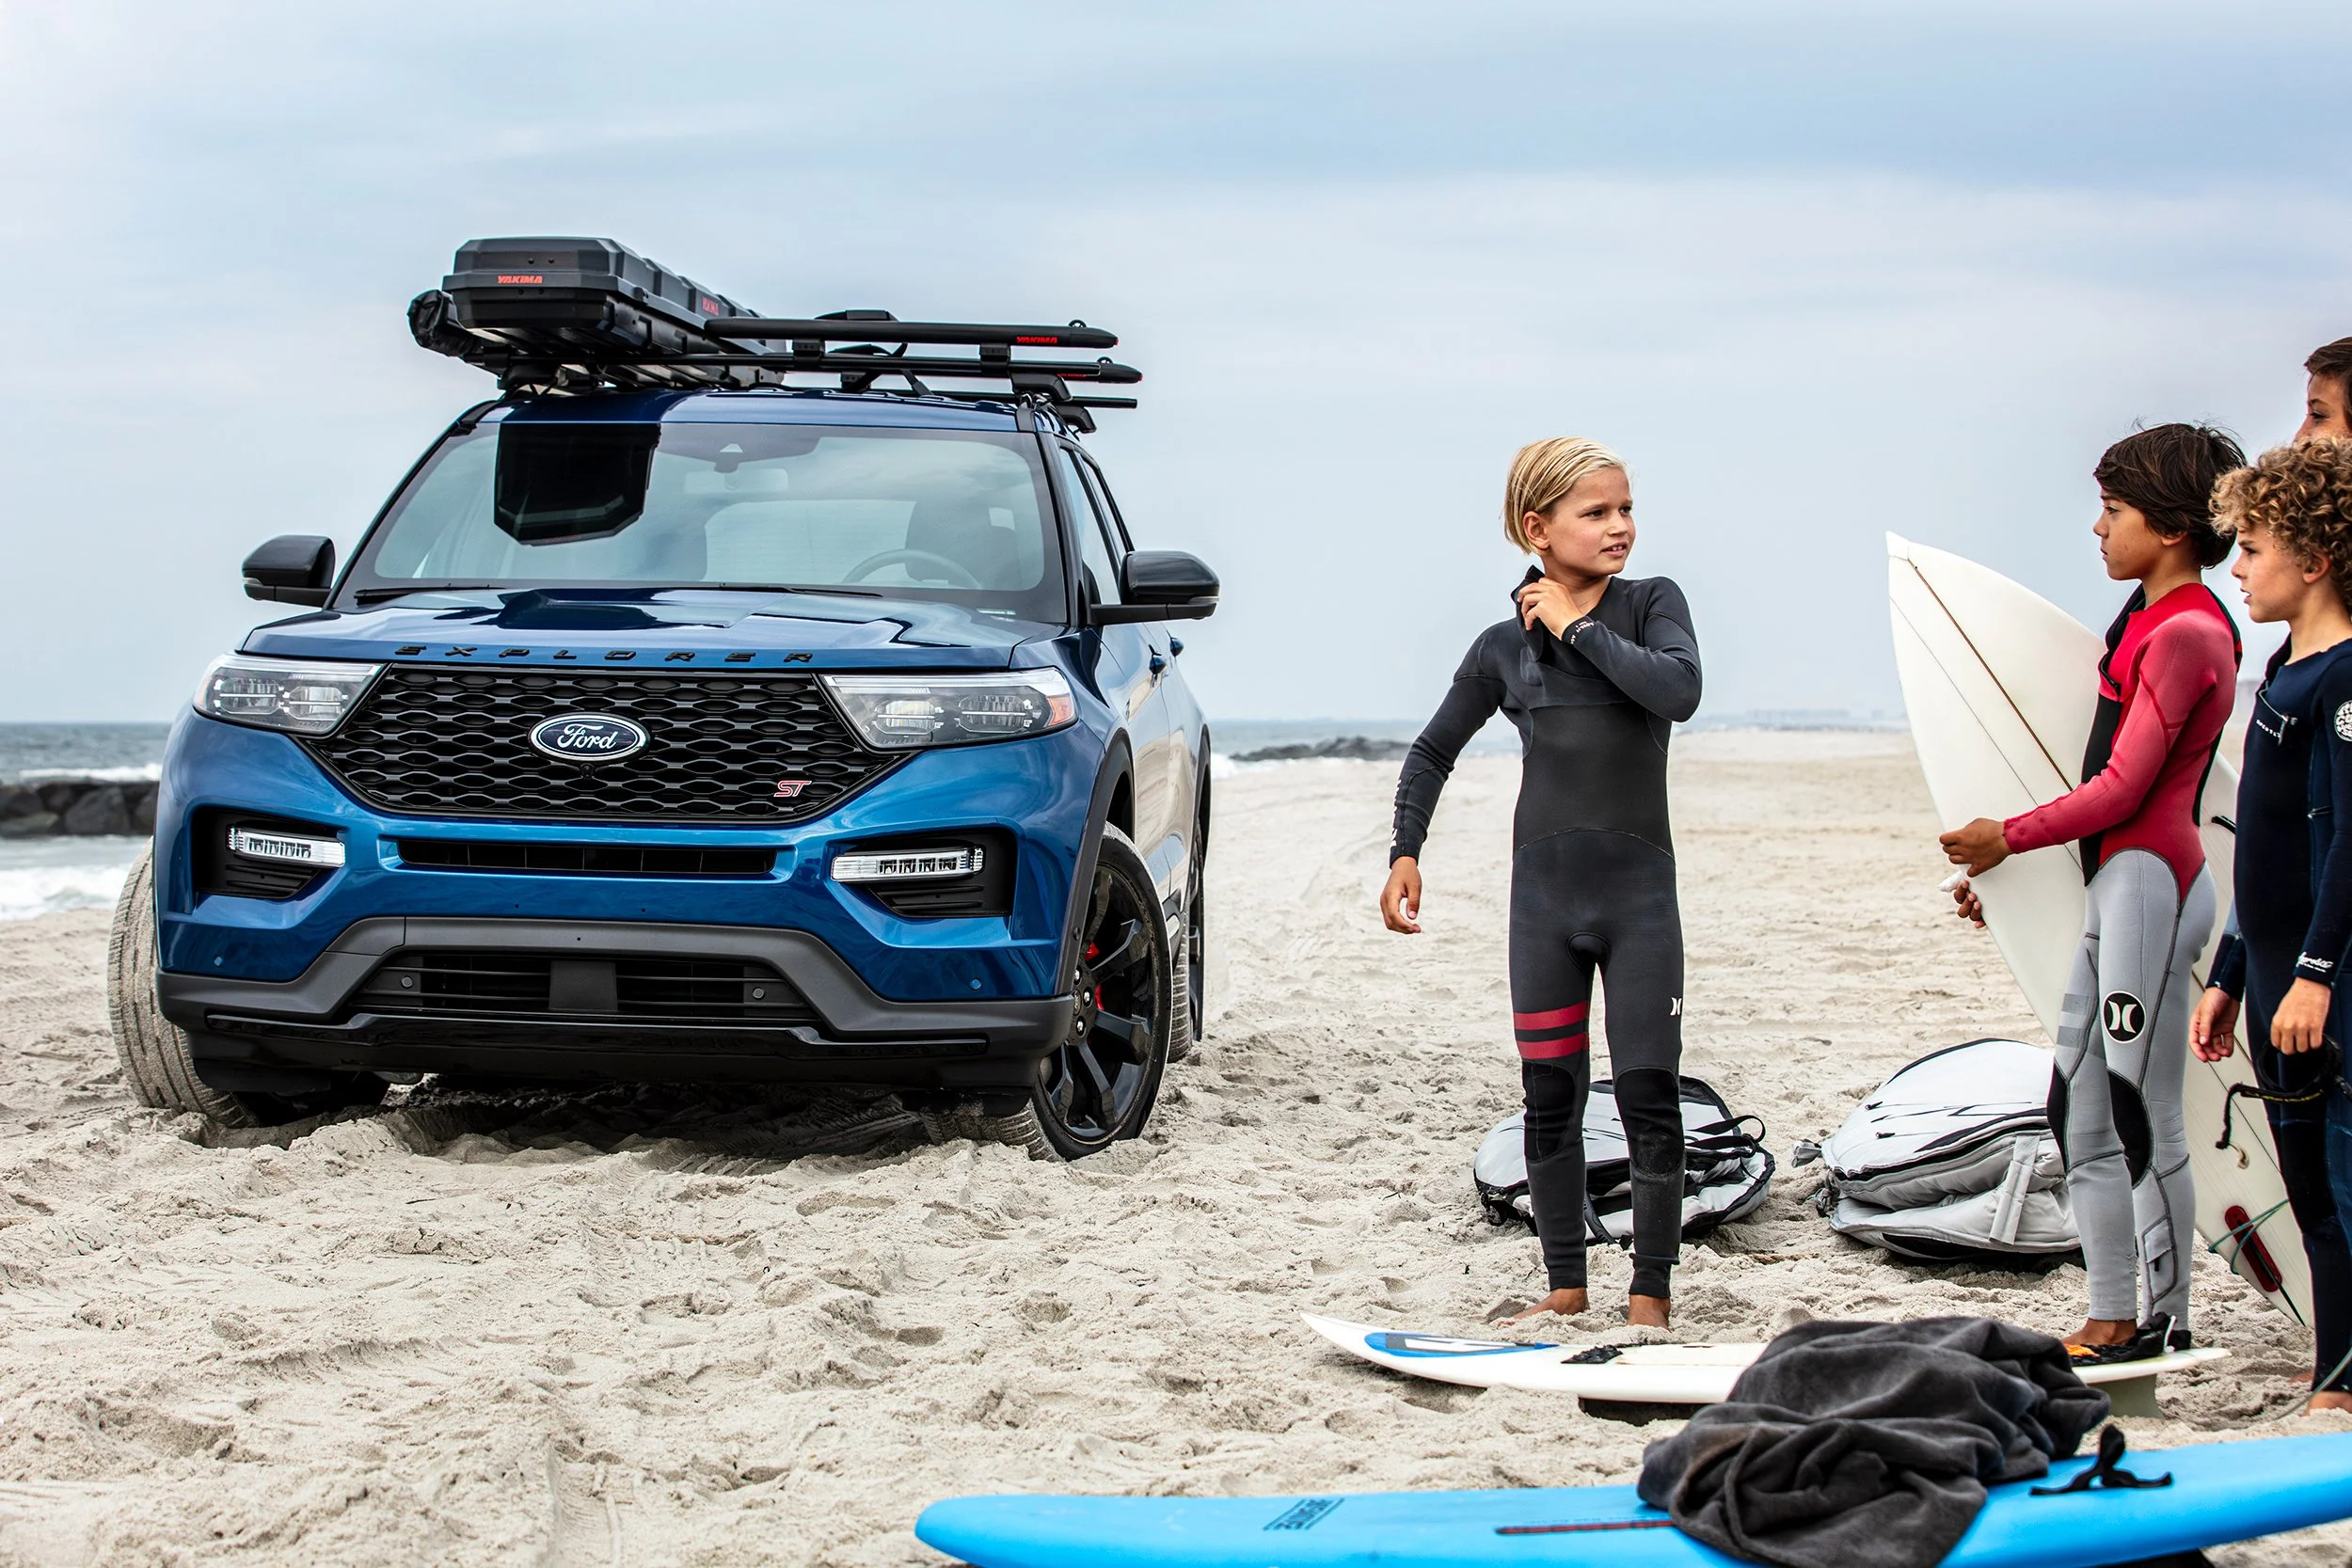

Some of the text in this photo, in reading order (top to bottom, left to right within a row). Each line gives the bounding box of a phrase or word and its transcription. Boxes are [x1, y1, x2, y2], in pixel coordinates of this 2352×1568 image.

[498, 275, 543, 284] YAKIMA
[1016, 336, 1057, 344] YAKIMA
[394, 645, 814, 662] EXPLORER
[557, 723, 618, 749] Ford
[773, 780, 812, 798] ST
